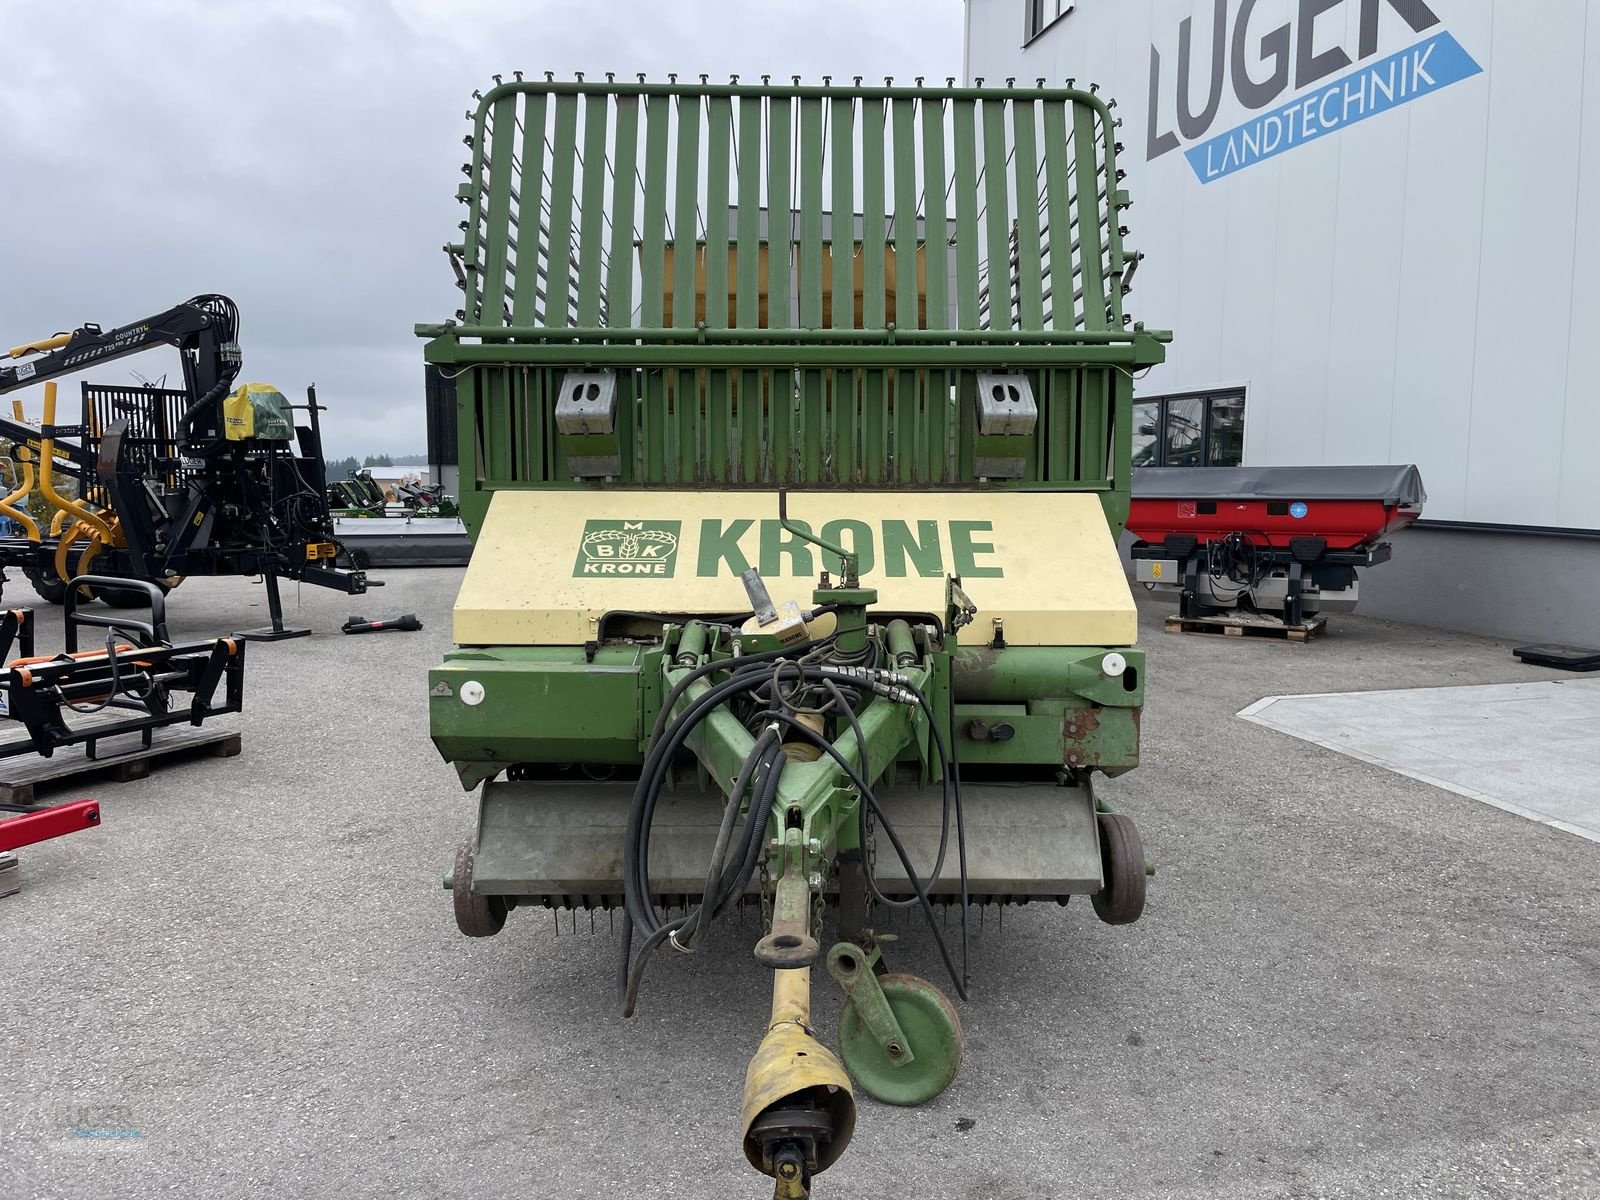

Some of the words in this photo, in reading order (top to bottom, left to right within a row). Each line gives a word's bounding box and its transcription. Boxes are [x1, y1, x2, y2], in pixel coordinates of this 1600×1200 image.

[1206, 42, 1437, 178] LANDTECHNIK
[115, 326, 145, 340] COUNTRY
[597, 545, 615, 557] B
[641, 545, 664, 557] K
[696, 519, 1004, 578] KRONE
[583, 563, 666, 574] KRONE
